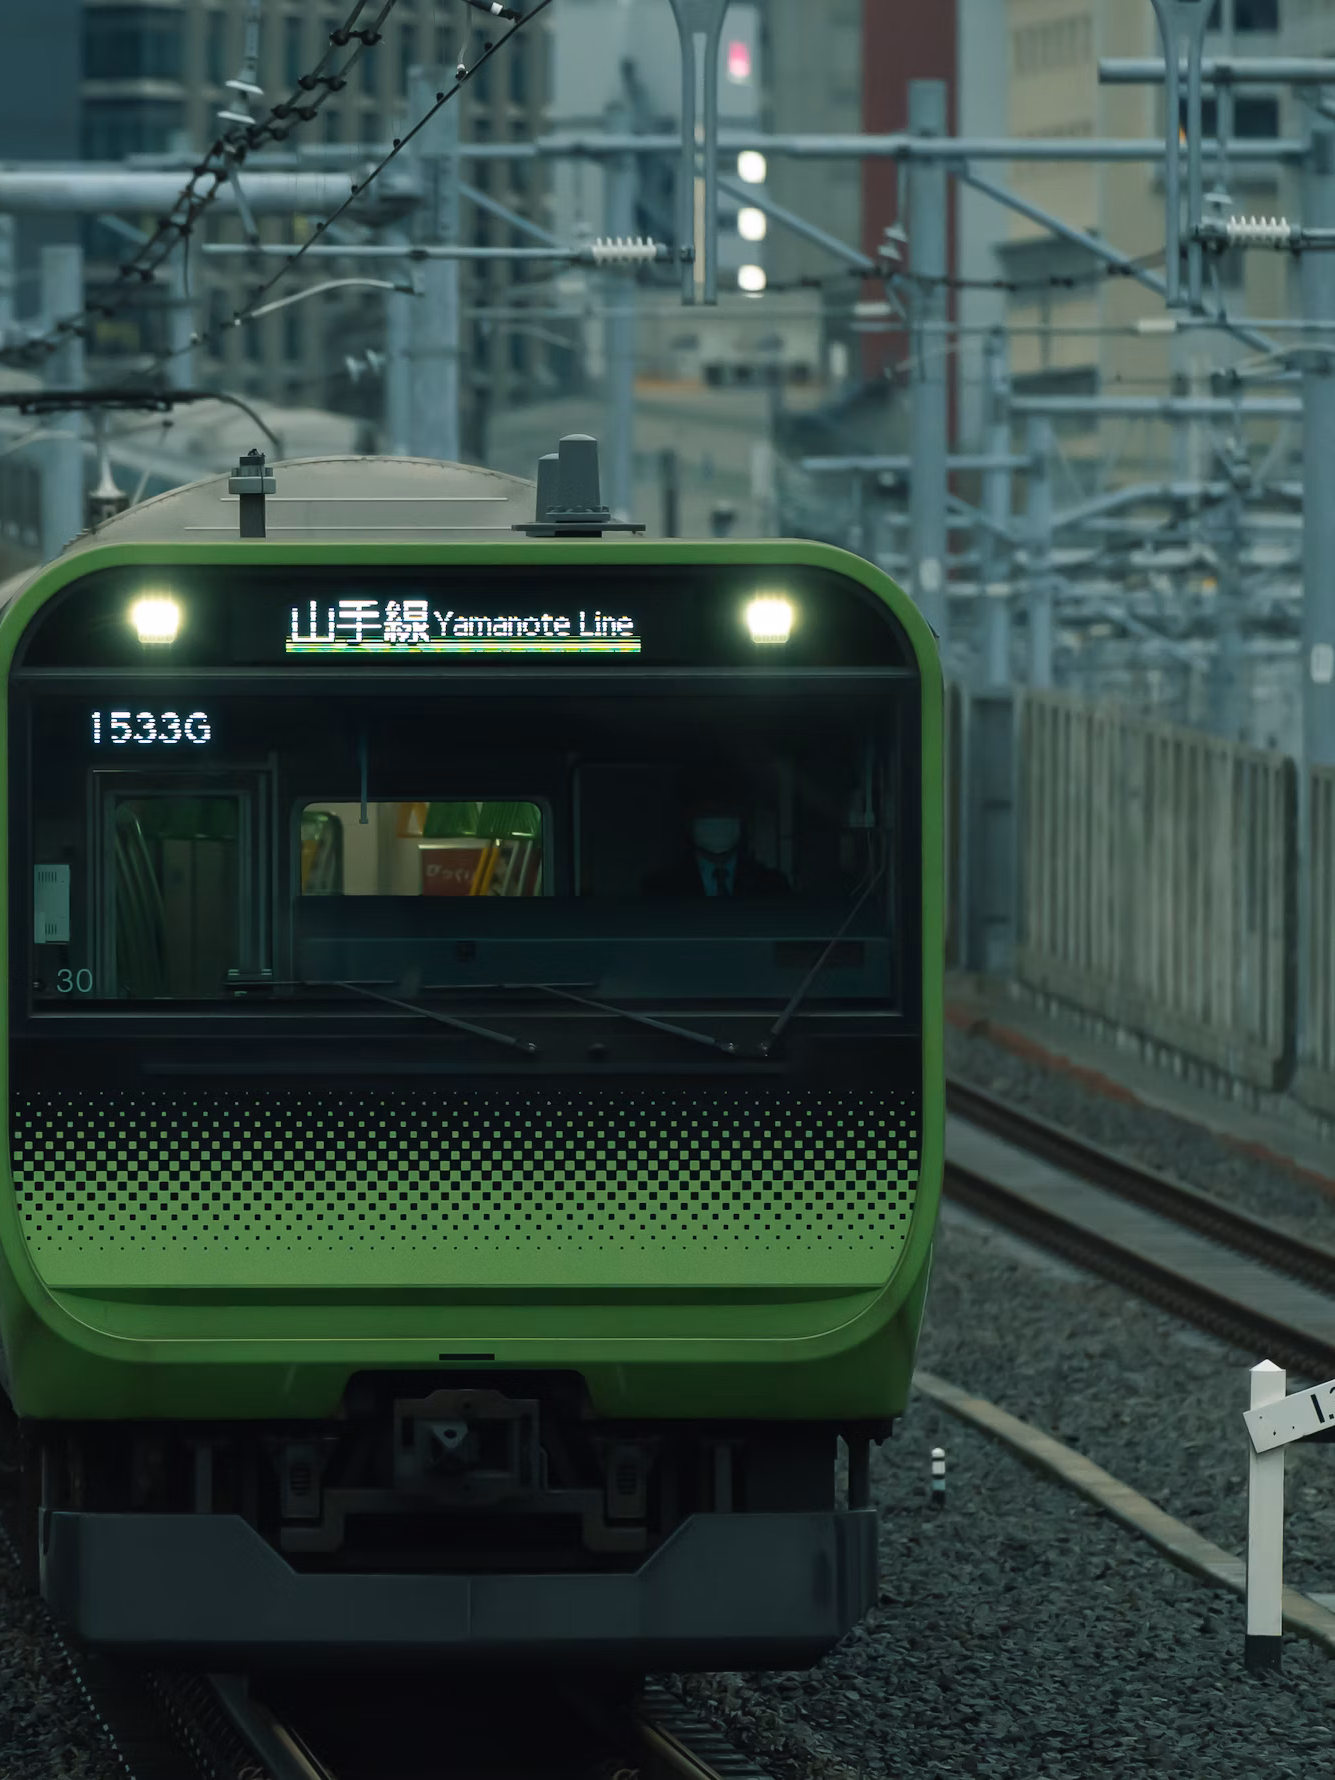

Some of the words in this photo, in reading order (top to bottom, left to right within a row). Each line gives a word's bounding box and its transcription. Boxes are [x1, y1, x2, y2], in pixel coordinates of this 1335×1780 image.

[291, 600, 430, 645] 山手線
[433, 610, 571, 637] Yamanote
[579, 610, 635, 637] Line
[91, 711, 212, 744] 1533G
[56, 968, 94, 993] 30
